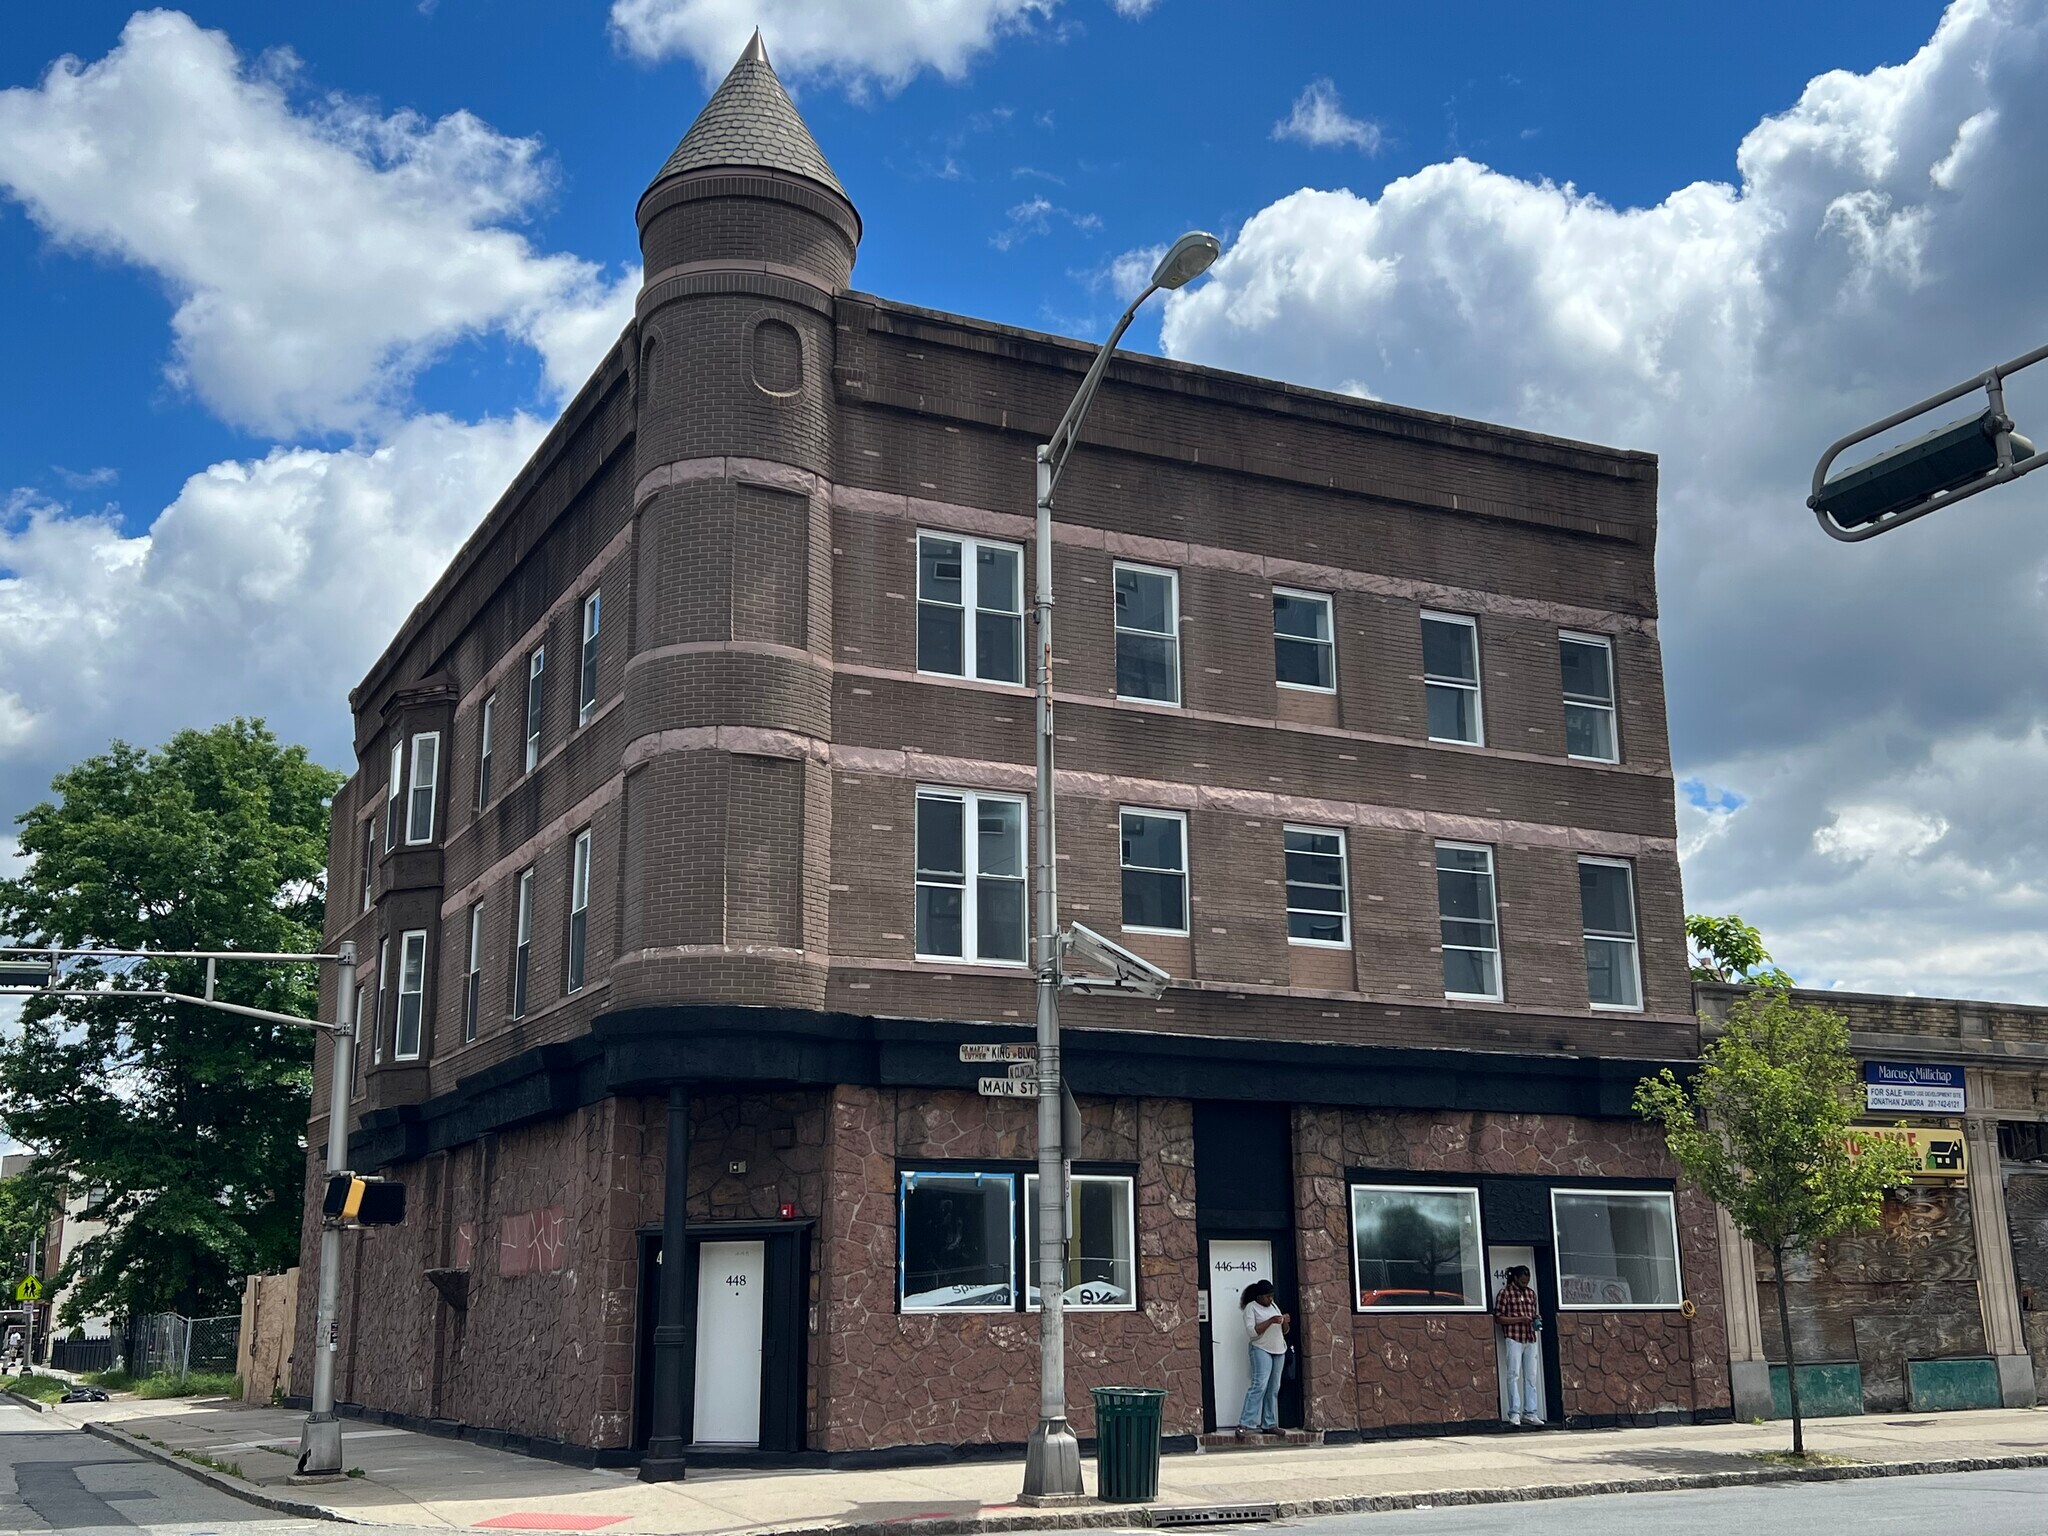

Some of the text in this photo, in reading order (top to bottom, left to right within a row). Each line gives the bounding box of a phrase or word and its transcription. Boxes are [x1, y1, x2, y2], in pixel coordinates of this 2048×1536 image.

[991, 1046, 1011, 1060] KING
[1017, 1047, 1036, 1060] BLVD
[1878, 1065, 1952, 1084] Marcus & Millichap
[983, 1080, 1034, 1095] MAIN ST
[1870, 1088, 1884, 1097] FOR
[1885, 1089, 1902, 1097] SALE
[1870, 1098, 1900, 1106] JONATHAN
[1900, 1099, 1925, 1107] ZAMORA
[725, 1274, 747, 1287] 448
